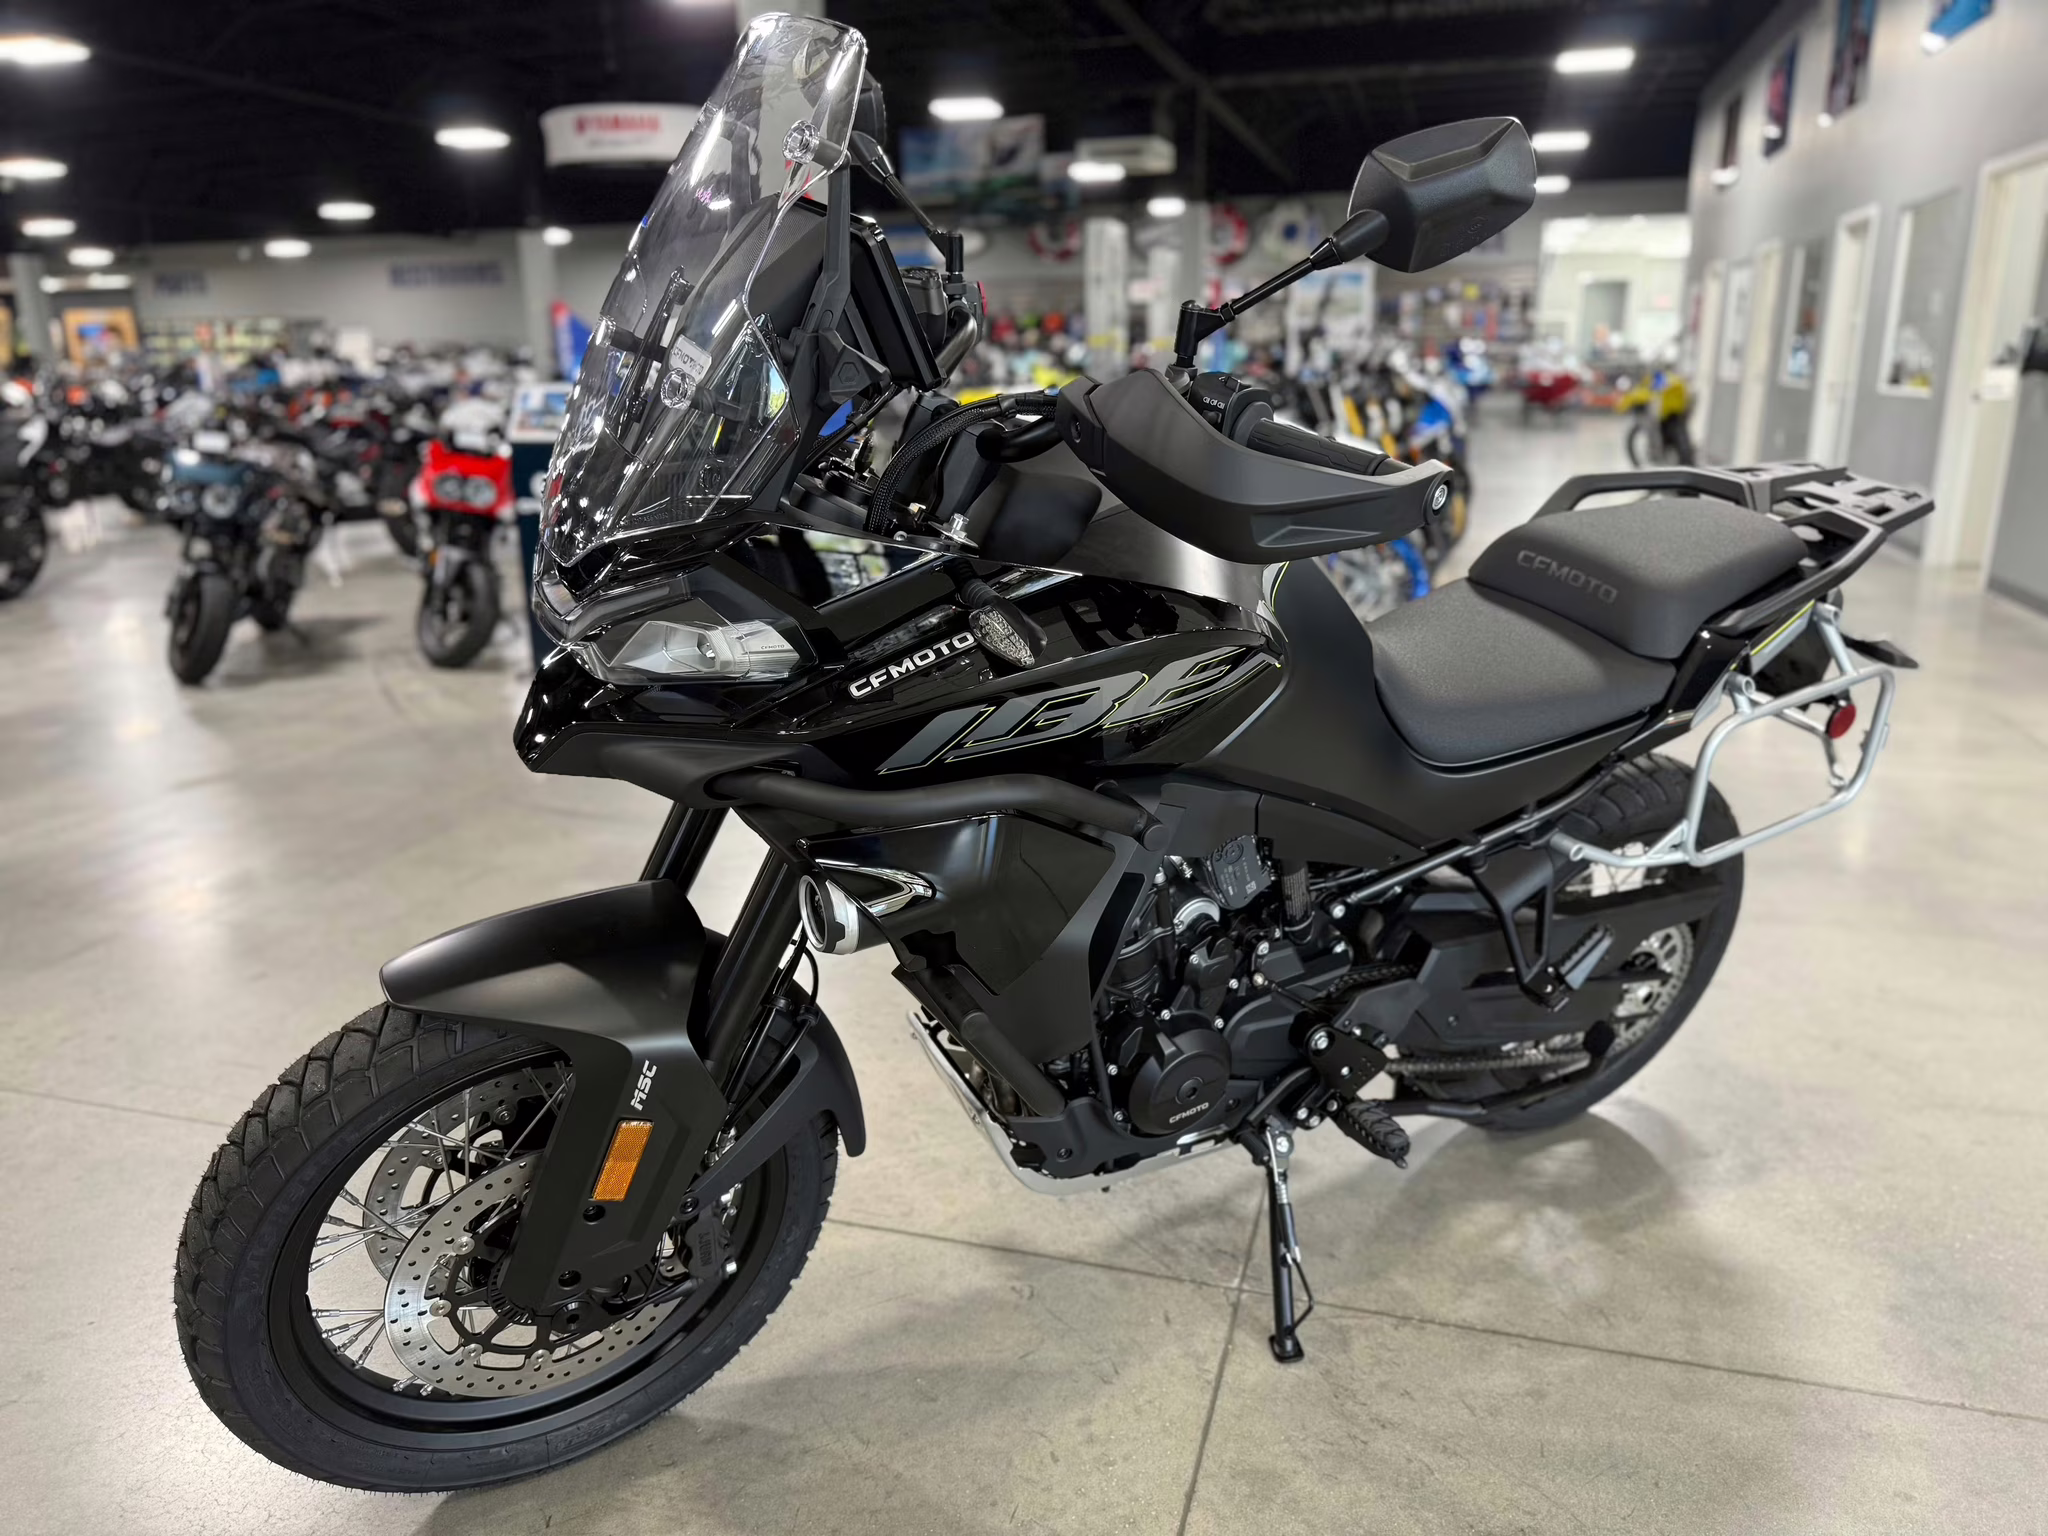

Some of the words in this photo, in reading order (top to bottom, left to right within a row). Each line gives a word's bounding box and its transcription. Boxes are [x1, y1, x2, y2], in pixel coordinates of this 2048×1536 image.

[1517, 550, 1618, 603] CFMOTO
[850, 631, 975, 697] CFMOTO
[630, 1059, 657, 1111] MSC
[1169, 1101, 1209, 1124] CFMOTO
